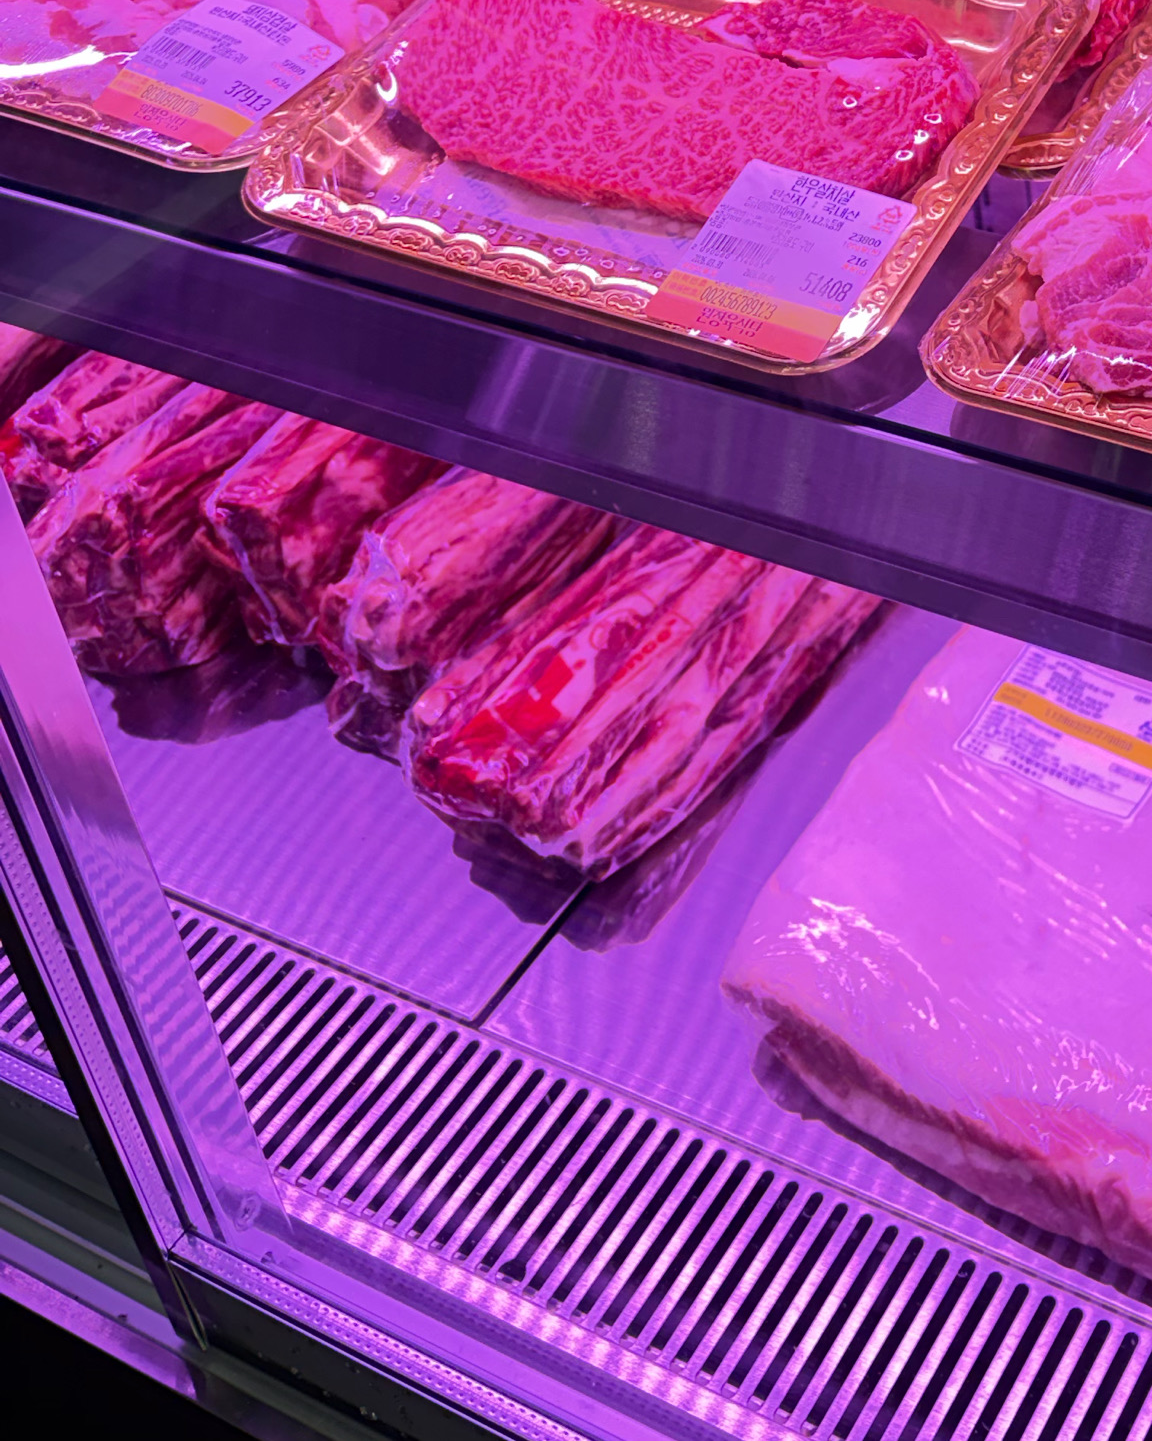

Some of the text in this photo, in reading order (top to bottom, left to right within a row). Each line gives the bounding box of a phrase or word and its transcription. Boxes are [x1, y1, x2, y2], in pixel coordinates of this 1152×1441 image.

[280, 59, 306, 77] 5980
[224, 80, 272, 112] 37913
[271, 77, 291, 91] 634
[769, 188, 806, 207] 원산지
[823, 202, 861, 222] 국내산
[792, 176, 857, 205] 한우살치살
[848, 232, 882, 248] 23800
[846, 256, 868, 268] 216
[799, 271, 853, 303] 51408
[700, 285, 778, 320] 002456789123
[696, 307, 764, 338] 원정육식당
